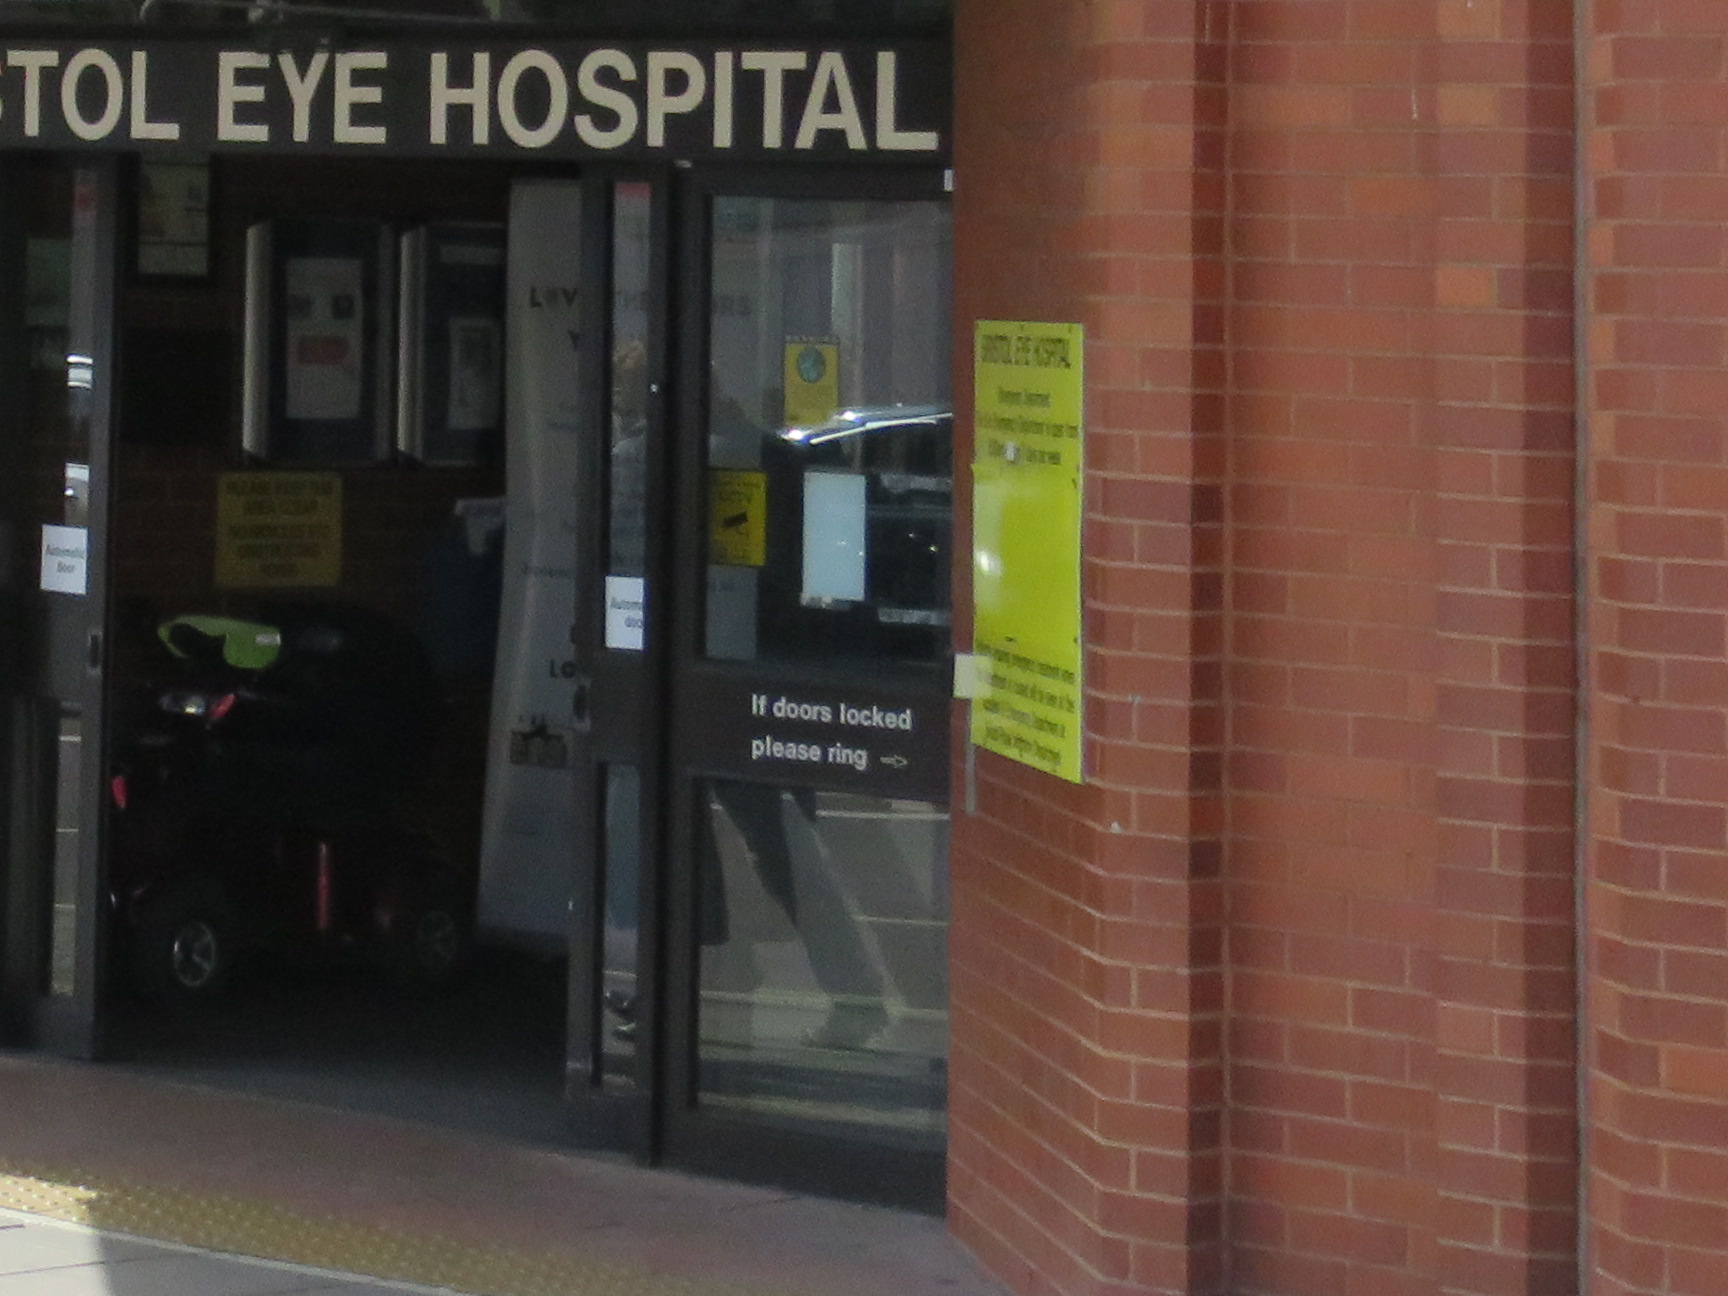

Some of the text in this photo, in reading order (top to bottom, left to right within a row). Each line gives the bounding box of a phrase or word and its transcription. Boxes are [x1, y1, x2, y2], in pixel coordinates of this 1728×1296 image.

[217, 50, 388, 146] EYE
[429, 48, 941, 152] HOSPITAL
[751, 693, 912, 731] If doors locked
[751, 734, 869, 771] please ring
